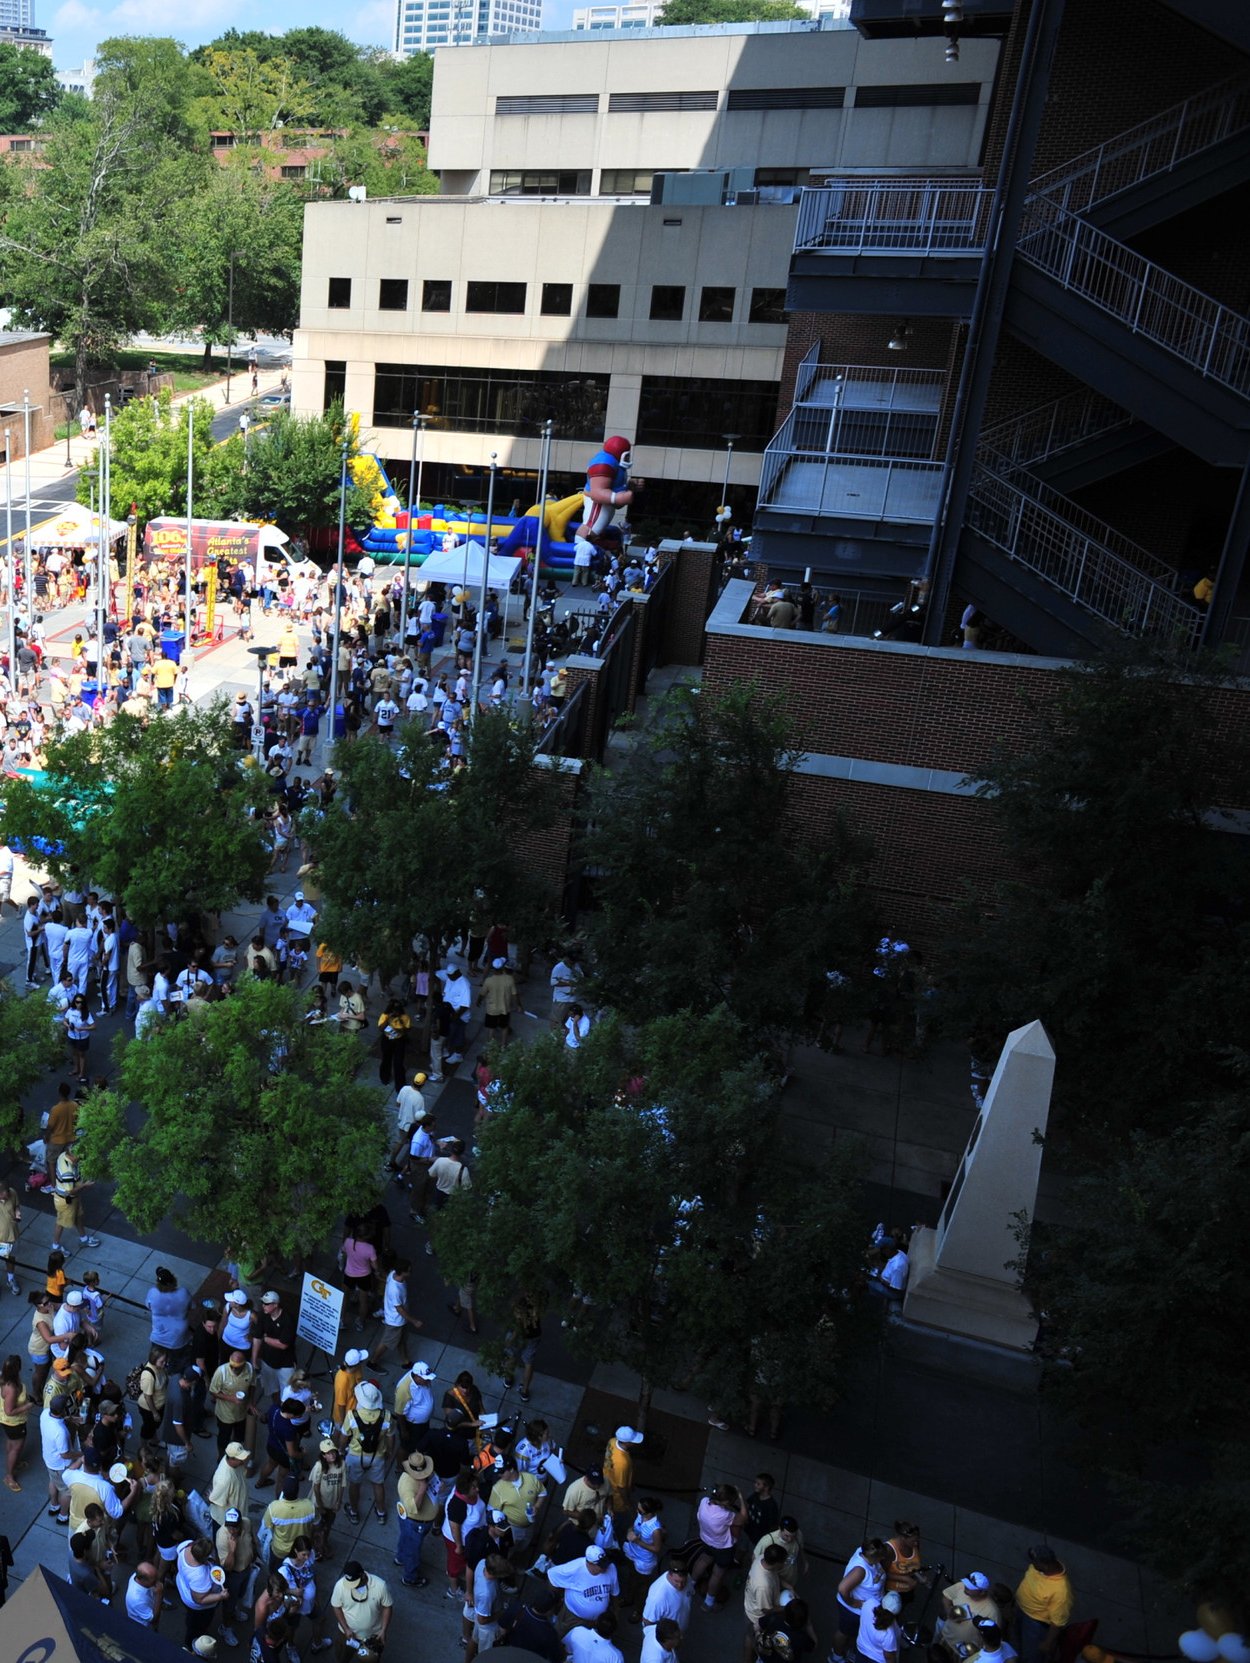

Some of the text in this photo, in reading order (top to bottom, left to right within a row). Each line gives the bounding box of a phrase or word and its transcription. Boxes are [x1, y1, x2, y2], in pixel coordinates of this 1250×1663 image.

[207, 537, 249, 546] Atlanta's
[207, 546, 248, 556] Greatest
[381, 709, 392, 720] 21
